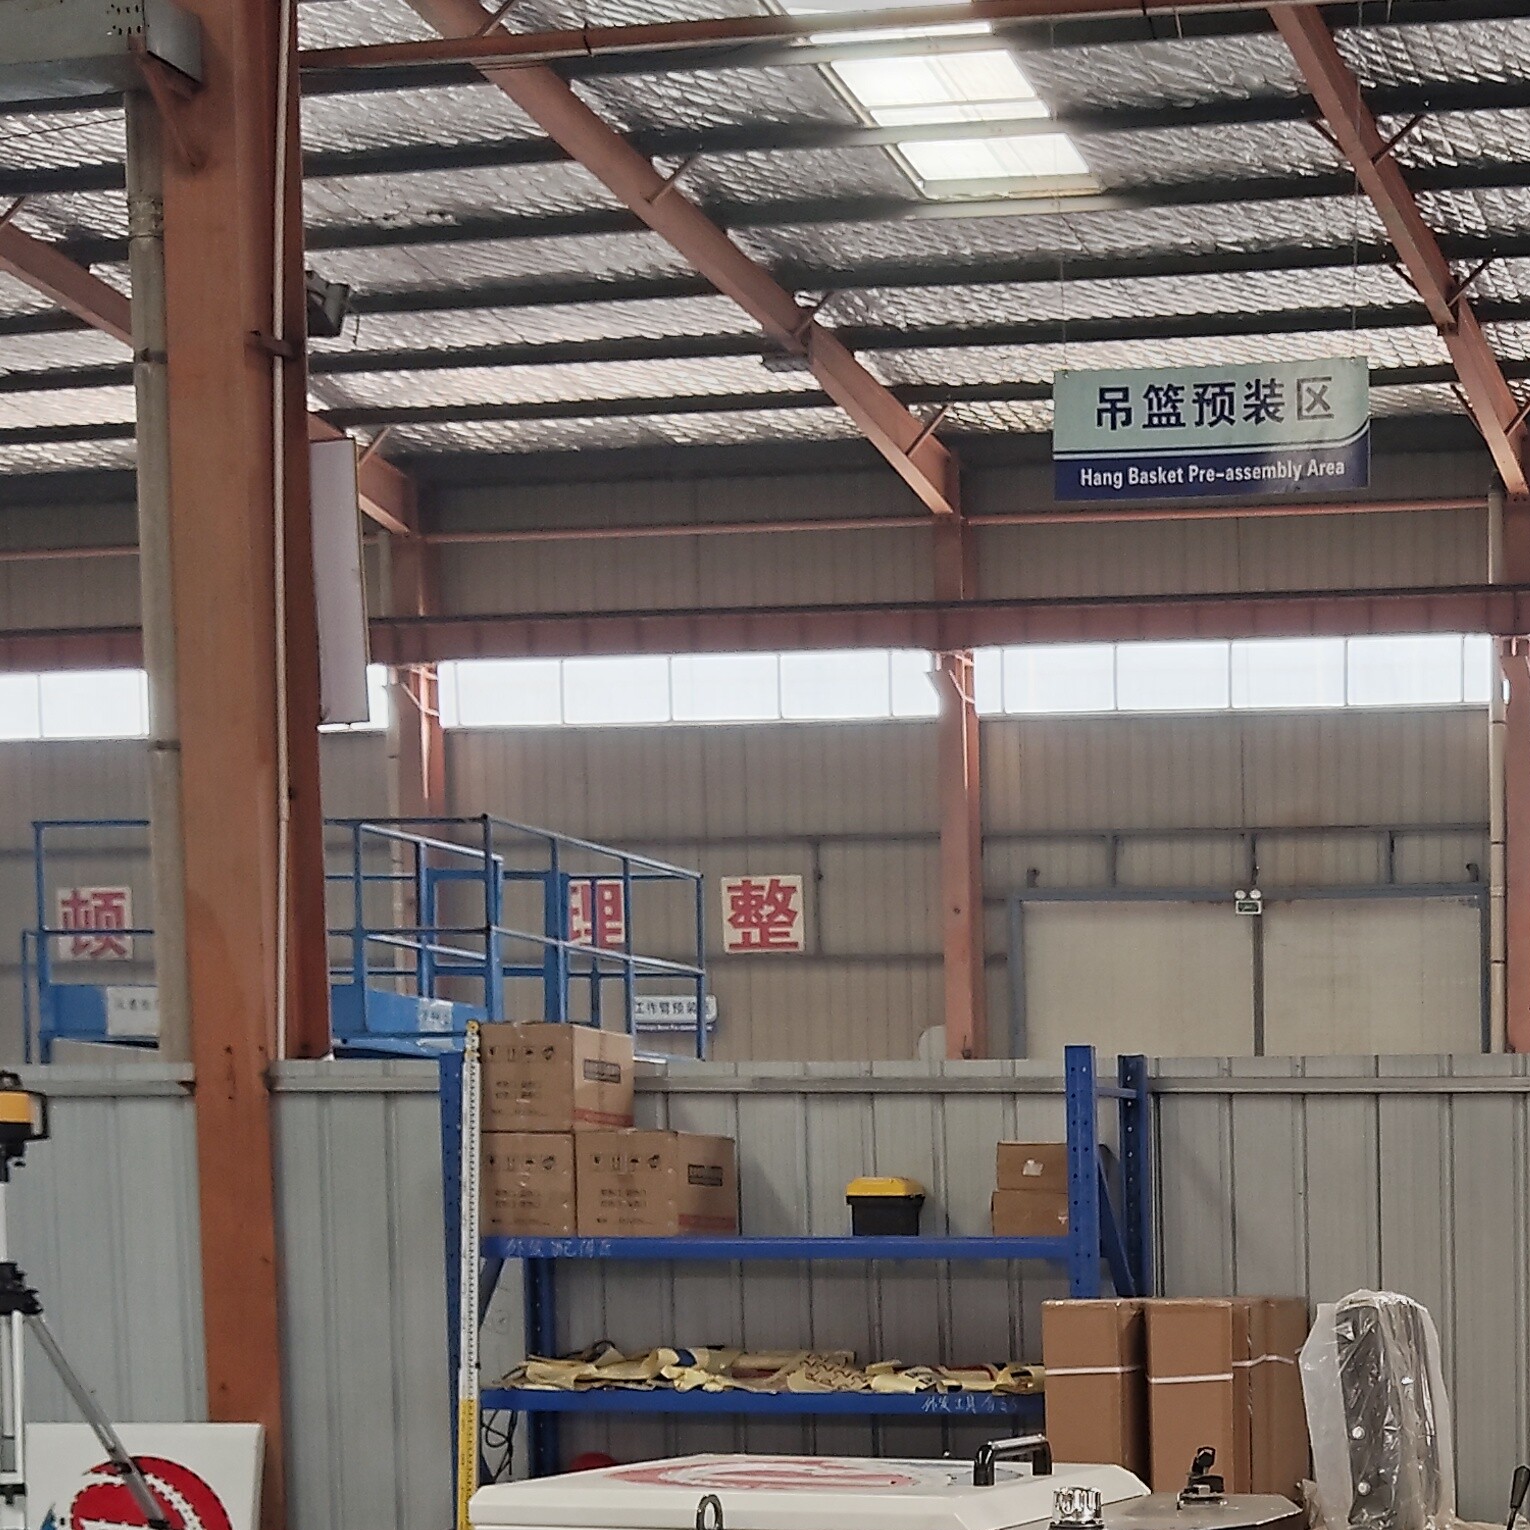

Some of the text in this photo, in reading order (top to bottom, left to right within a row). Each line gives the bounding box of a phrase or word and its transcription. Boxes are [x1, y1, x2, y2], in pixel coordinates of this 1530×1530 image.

[1096, 376, 1334, 431] 吊篮预装区
[1080, 458, 1345, 489] Hang Basket Pre-assembly Area
[60, 889, 127, 956] 顿
[727, 878, 800, 950] 整
